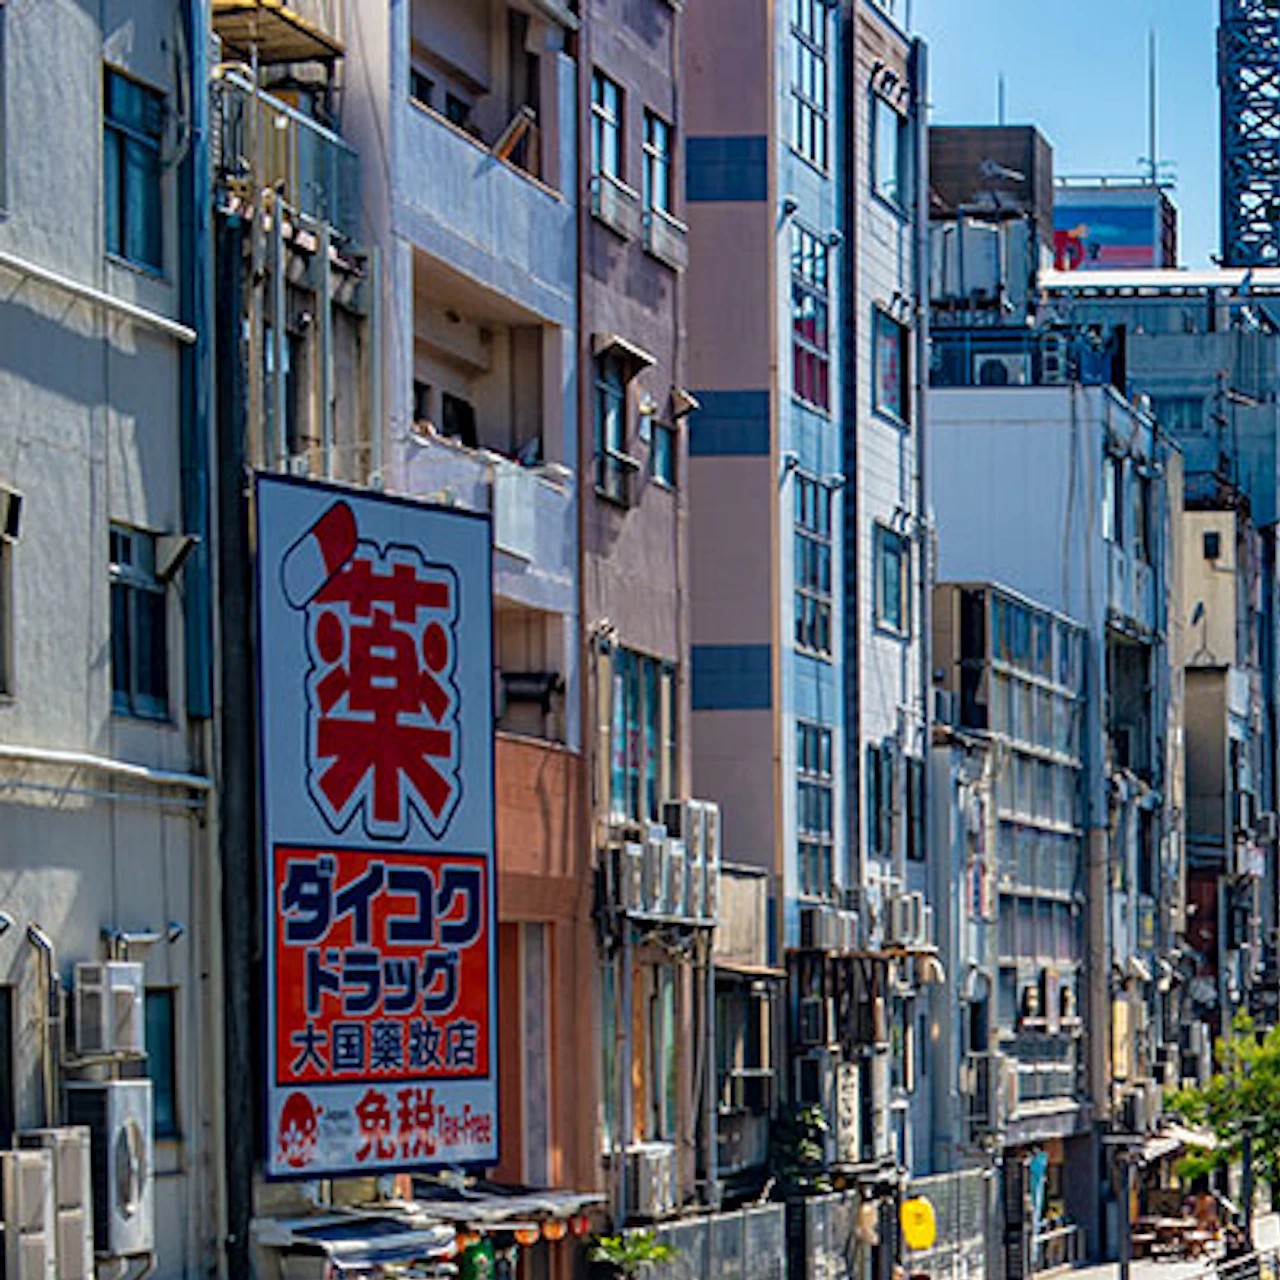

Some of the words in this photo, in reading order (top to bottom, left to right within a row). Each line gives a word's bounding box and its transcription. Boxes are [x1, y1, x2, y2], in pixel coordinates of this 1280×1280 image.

[309, 554, 456, 826] 薬
[279, 857, 484, 945] ダイコク
[305, 949, 461, 1017] ドラッグ
[354, 1088, 437, 1163] 免税
